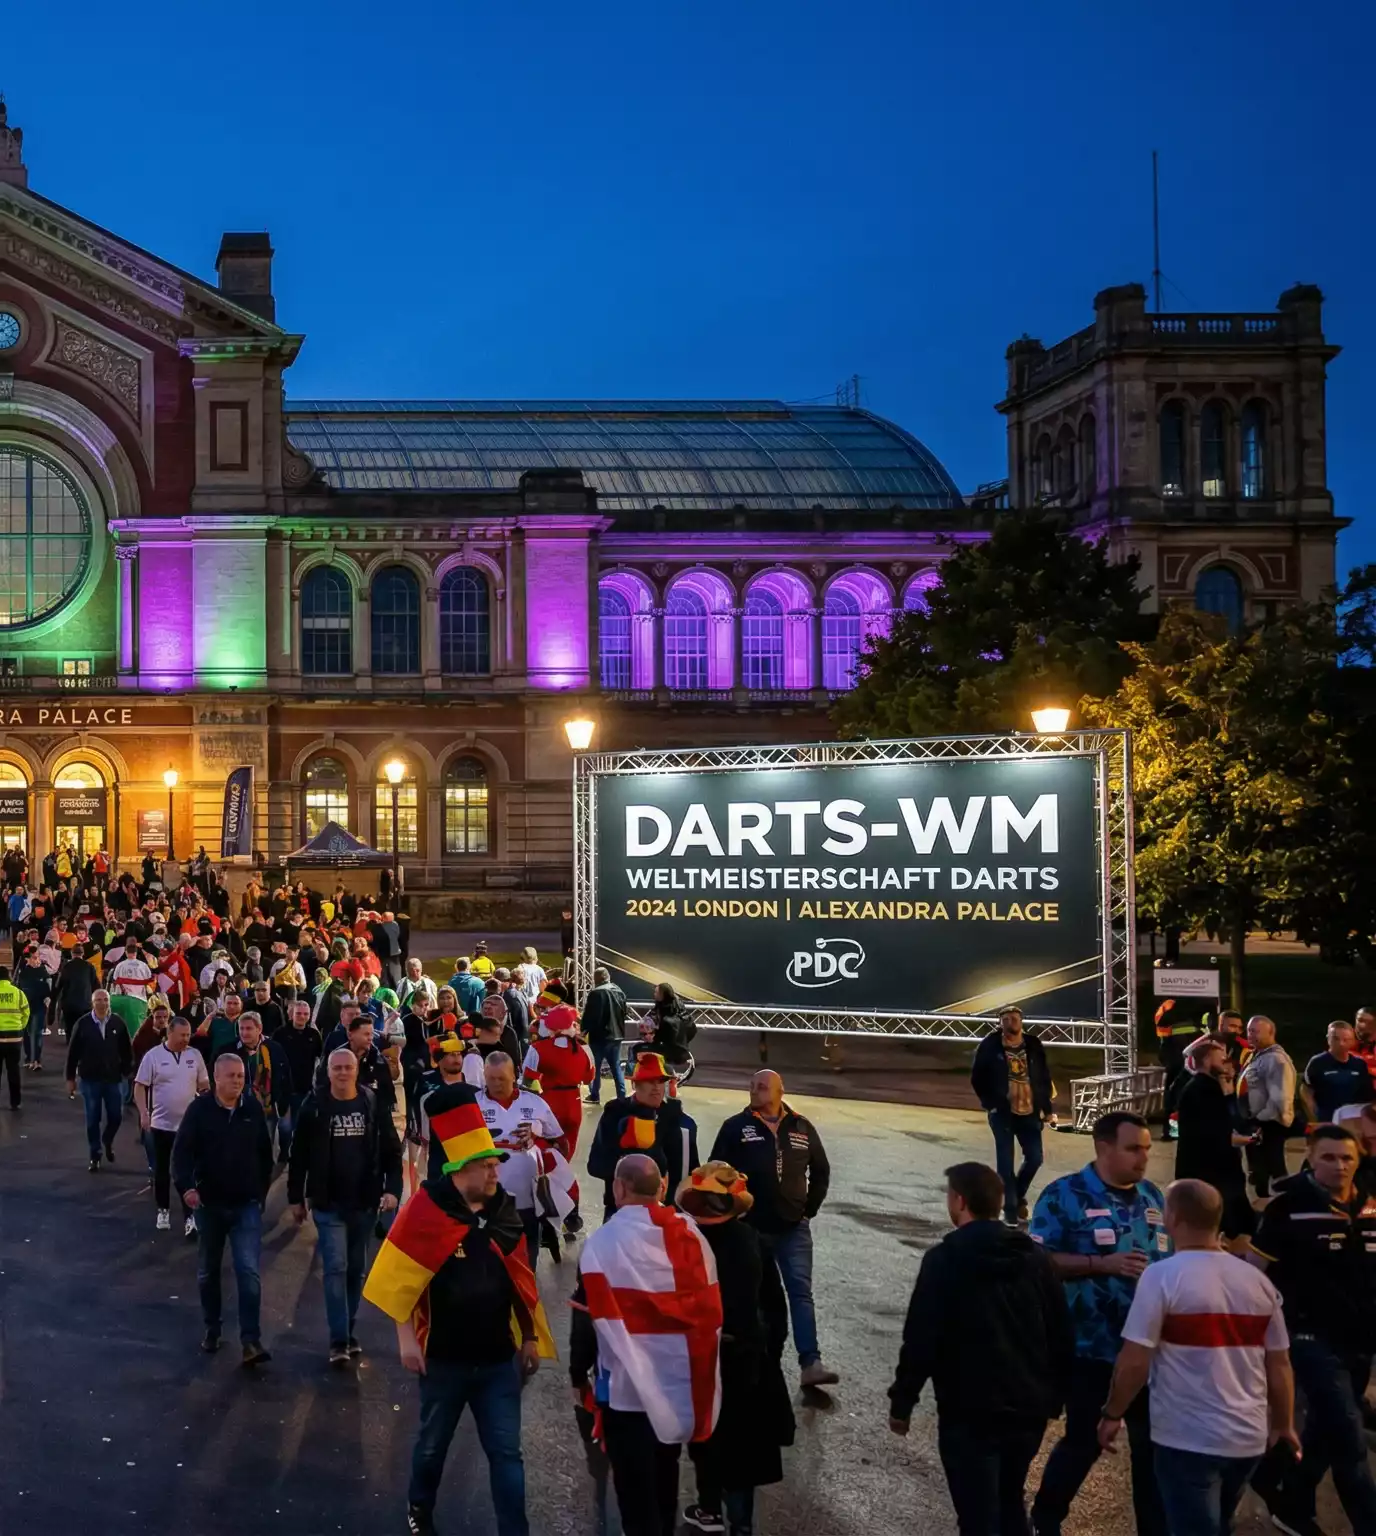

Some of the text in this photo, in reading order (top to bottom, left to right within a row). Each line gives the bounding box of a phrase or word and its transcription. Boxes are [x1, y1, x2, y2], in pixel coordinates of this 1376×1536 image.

[39, 708, 133, 725] PALACE
[625, 793, 1060, 857] DARTS-WM
[625, 866, 1060, 891] WELTMEISTERSCHAFT DARTS
[625, 899, 678, 917] 2024
[683, 899, 779, 918] LONDON
[798, 900, 950, 920] ALEXANDRA
[957, 901, 1060, 922] PALACE
[793, 951, 860, 979] PDC
